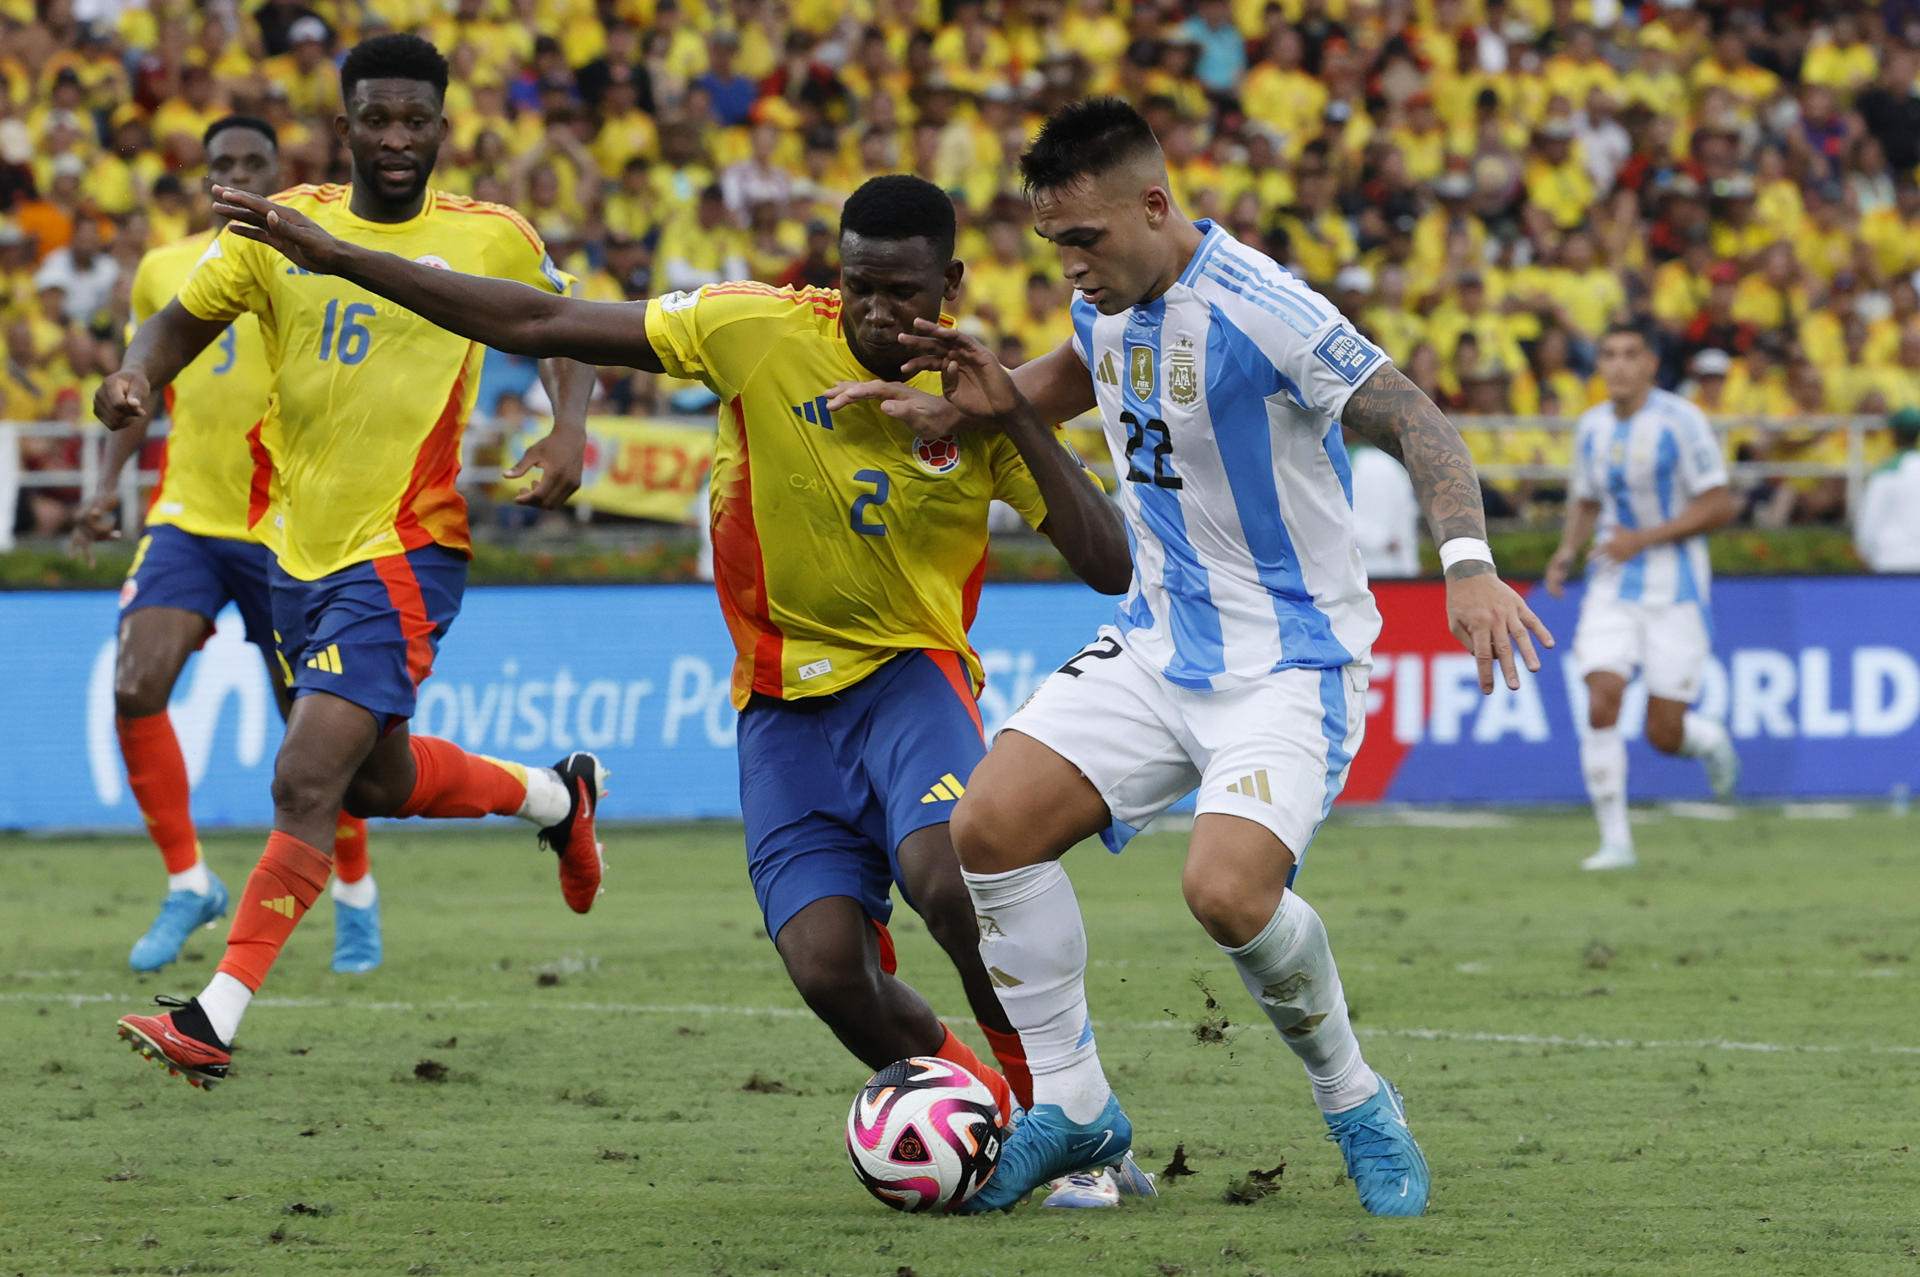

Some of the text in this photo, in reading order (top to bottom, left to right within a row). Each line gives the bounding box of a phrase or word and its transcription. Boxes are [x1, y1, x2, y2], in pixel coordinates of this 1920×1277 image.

[319, 298, 376, 365] 16
[1119, 411, 1183, 489] 22
[850, 469, 890, 536] 2
[413, 657, 655, 752] ovistar
